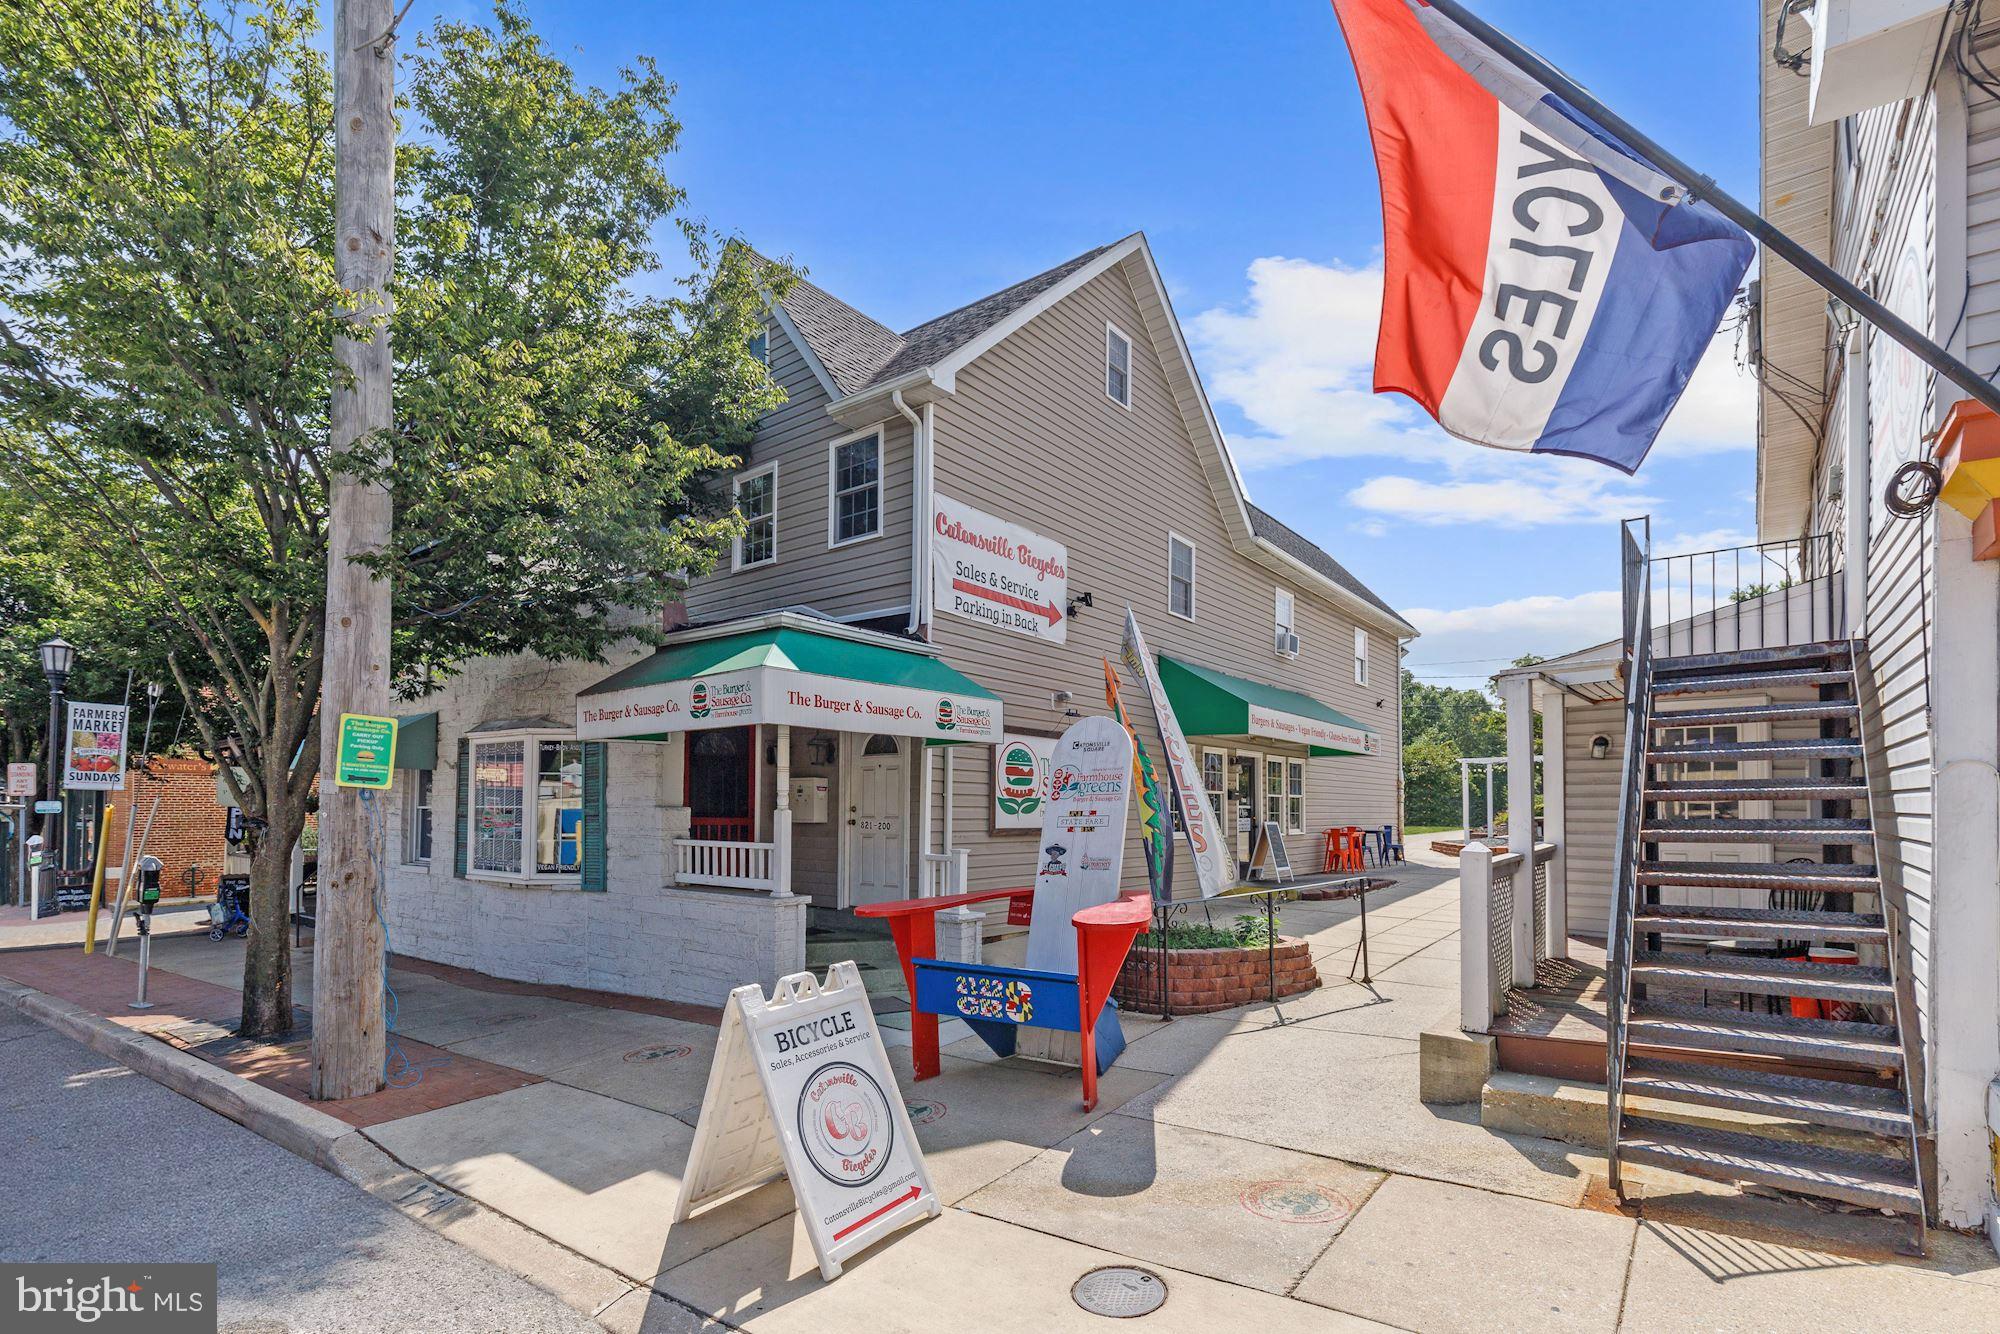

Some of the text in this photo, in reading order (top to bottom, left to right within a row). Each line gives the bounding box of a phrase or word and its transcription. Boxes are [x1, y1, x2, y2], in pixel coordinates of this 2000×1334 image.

[936, 511, 1065, 582] Catonsville Bicycles
[956, 560, 1039, 601] Sales & Service
[954, 595, 1038, 632] Parking in Back
[711, 686, 723, 696] The
[722, 684, 745, 696] Burger
[583, 700, 681, 723] The Burger & Sausage Co.
[711, 696, 740, 708] Sausage
[788, 690, 922, 720] The Burger & Sausage Co.
[73, 707, 125, 721] FARMERS
[956, 714, 981, 726] Sausage
[72, 718, 124, 732] MARKET
[1276, 720, 1296, 733] Sausages
[1311, 724, 1326, 741] Friendly
[1072, 741, 1110, 750] CATONSVILLE
[69, 771, 121, 782] SUNDAYS
[1077, 772, 1123, 782] Farmhouse
[1078, 781, 1122, 797] greens
[860, 821, 891, 830] 821-200
[774, 1011, 856, 1054] BICYCLE
[770, 1030, 870, 1072] Sales, Accessories & Service
[810, 1072, 859, 1103] Catonsville
[842, 1148, 877, 1176] Bicycles
[824, 1170, 917, 1226] CatonsvilleBicycles@gmail.com
